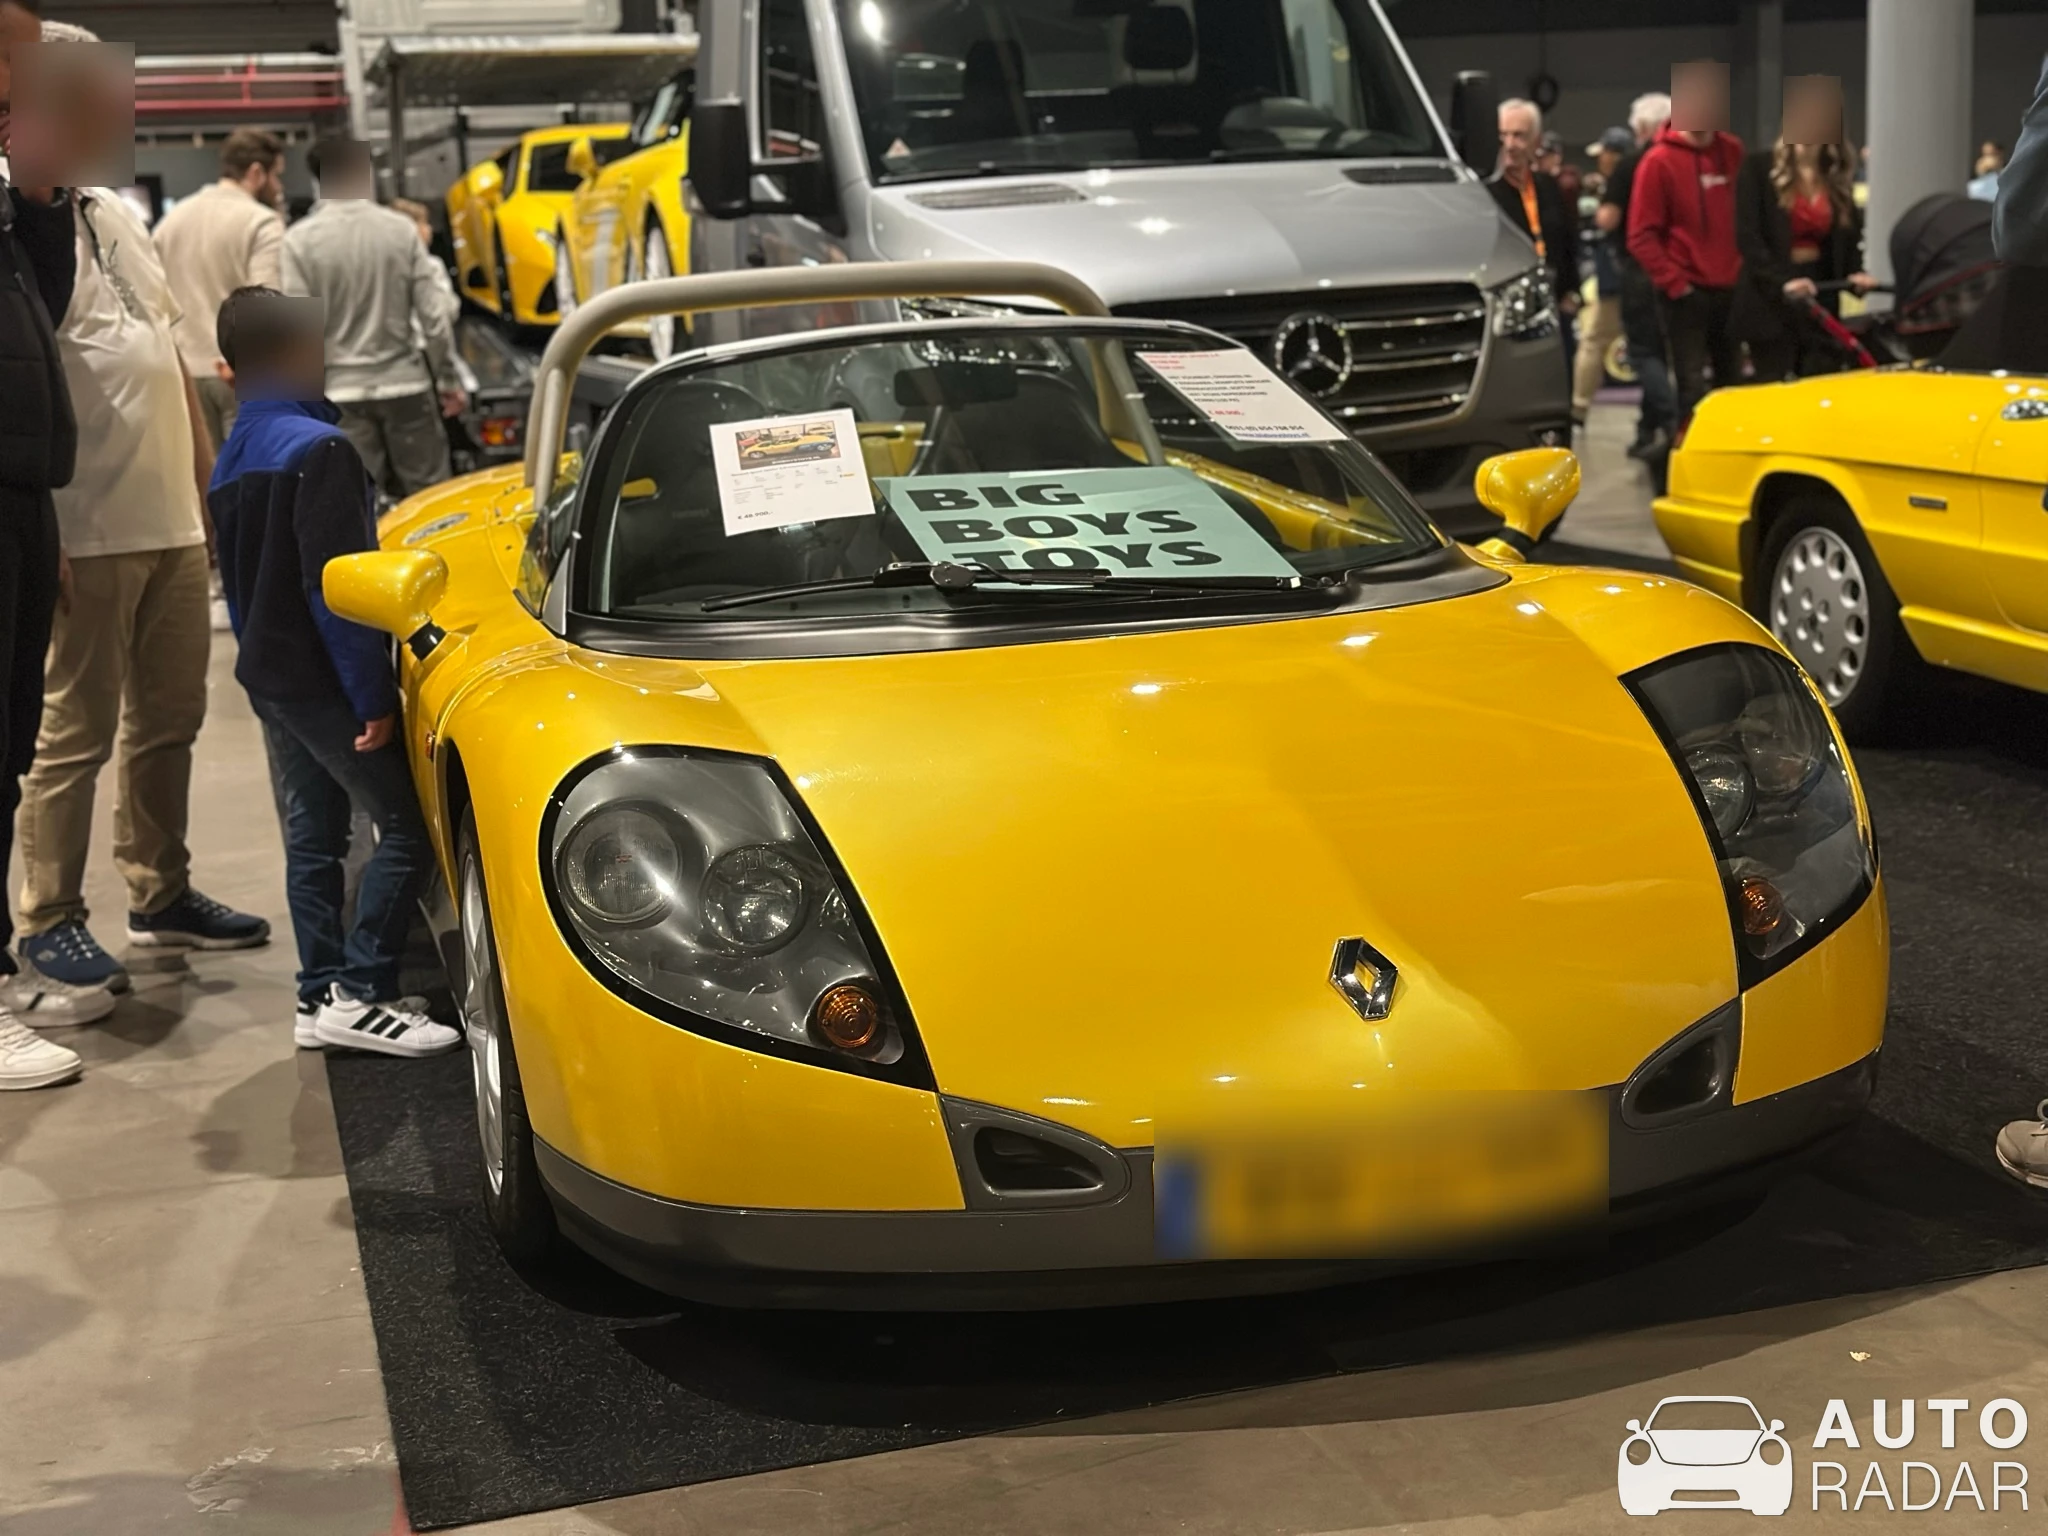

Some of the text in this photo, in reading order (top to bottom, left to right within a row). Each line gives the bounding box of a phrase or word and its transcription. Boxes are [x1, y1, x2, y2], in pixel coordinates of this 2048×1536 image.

[906, 484, 1084, 512] BIG
[928, 510, 1197, 544] BOYS
[952, 541, 1222, 570] TOYS
